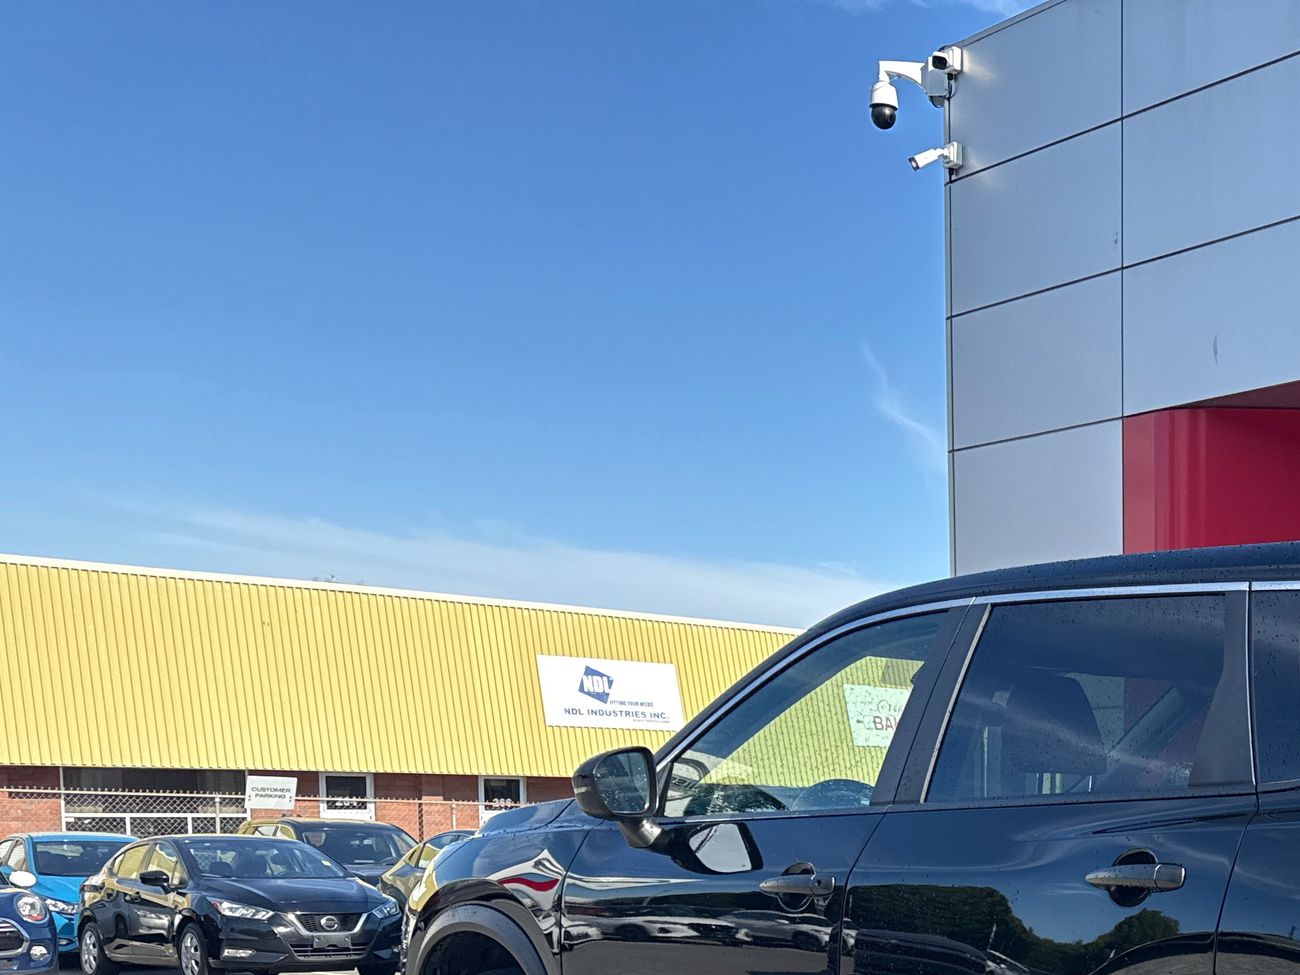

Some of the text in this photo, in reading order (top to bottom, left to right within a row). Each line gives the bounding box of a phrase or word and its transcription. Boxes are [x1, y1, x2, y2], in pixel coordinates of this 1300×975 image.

[581, 674, 612, 694] NDL
[564, 707, 670, 720] NDL INDUSTRIES INC.
[251, 786, 291, 794] CUSTOMER
